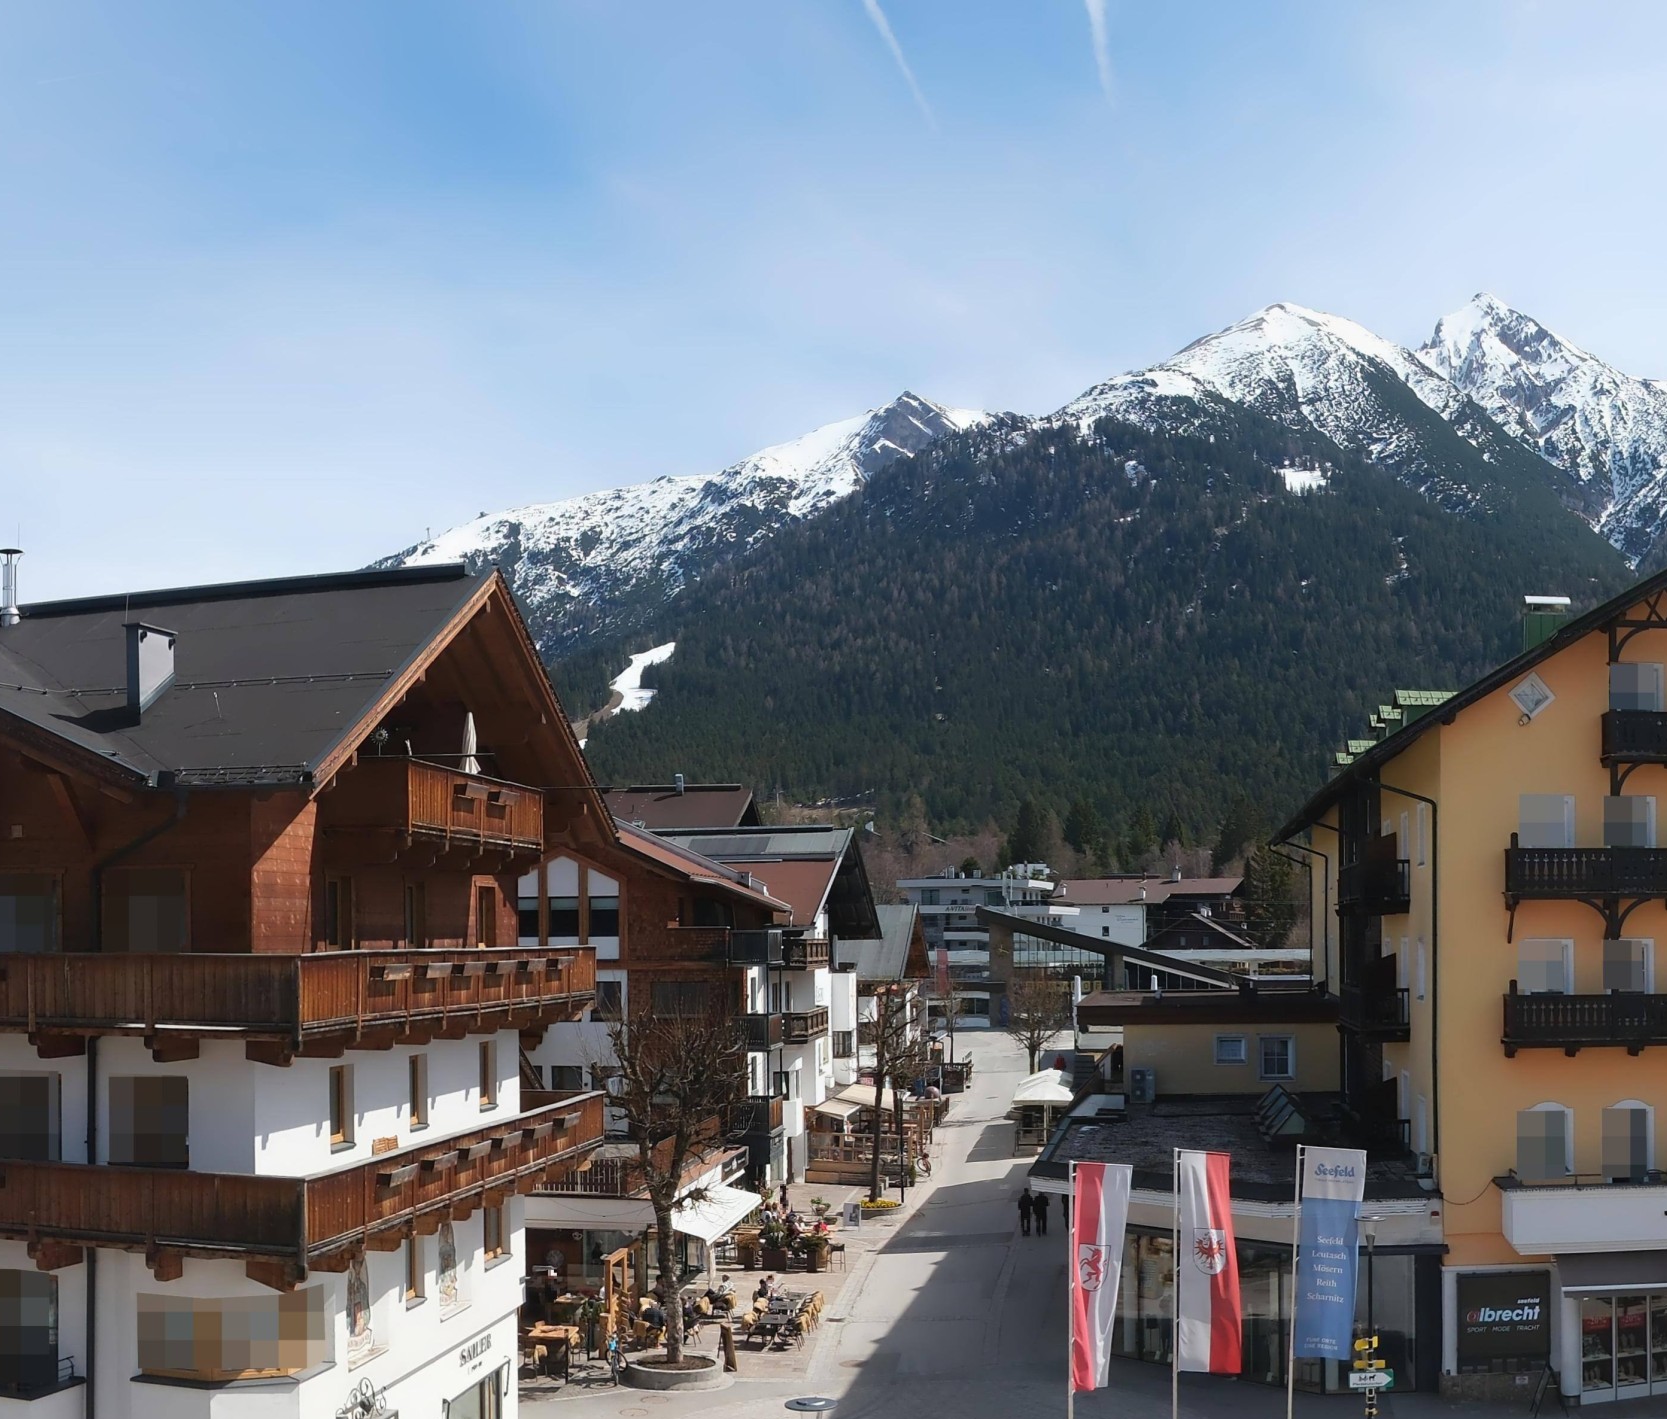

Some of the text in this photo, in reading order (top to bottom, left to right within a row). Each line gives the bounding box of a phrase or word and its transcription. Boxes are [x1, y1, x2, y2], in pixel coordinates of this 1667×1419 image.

[1314, 1163, 1355, 1178] Seefeld
[1317, 1234, 1344, 1246] Seefeld
[1312, 1249, 1347, 1260] Leutasch
[1312, 1263, 1344, 1274] Mösern
[1316, 1278, 1337, 1288] Reith
[1306, 1292, 1344, 1304] Scharnitz
[1516, 1324, 1540, 1332] TRACHT
